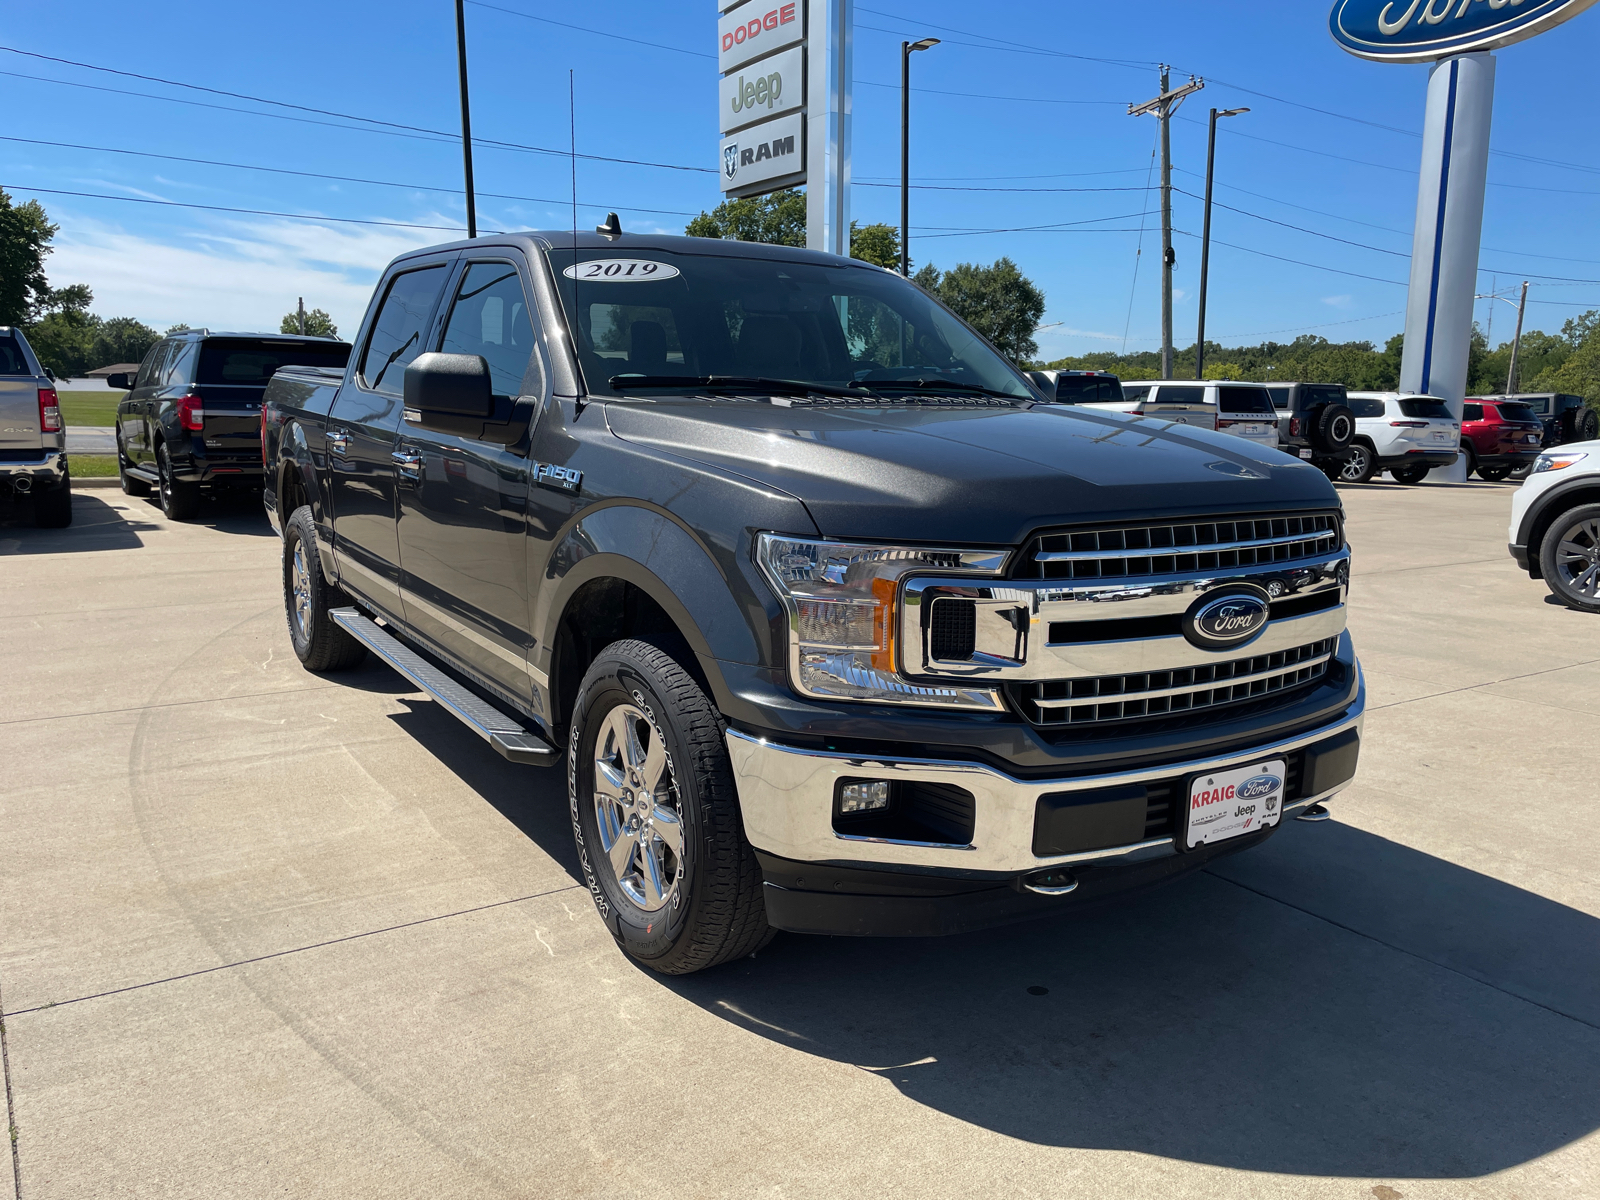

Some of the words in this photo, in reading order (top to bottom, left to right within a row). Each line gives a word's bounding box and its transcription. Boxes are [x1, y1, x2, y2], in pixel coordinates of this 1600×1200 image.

[722, 2, 796, 52] DODGE
[731, 71, 782, 113] Jeep
[740, 135, 795, 167] RAM
[584, 263, 658, 278] 2019
[1214, 604, 1256, 632] Ford
[1191, 784, 1236, 810] KRAIG
[1243, 778, 1272, 797] Ford
[568, 725, 610, 919] WRANGLER
[1191, 811, 1228, 824] CHRYSLER
[1234, 804, 1256, 818] Jeep
[1212, 820, 1247, 835] DODGE
